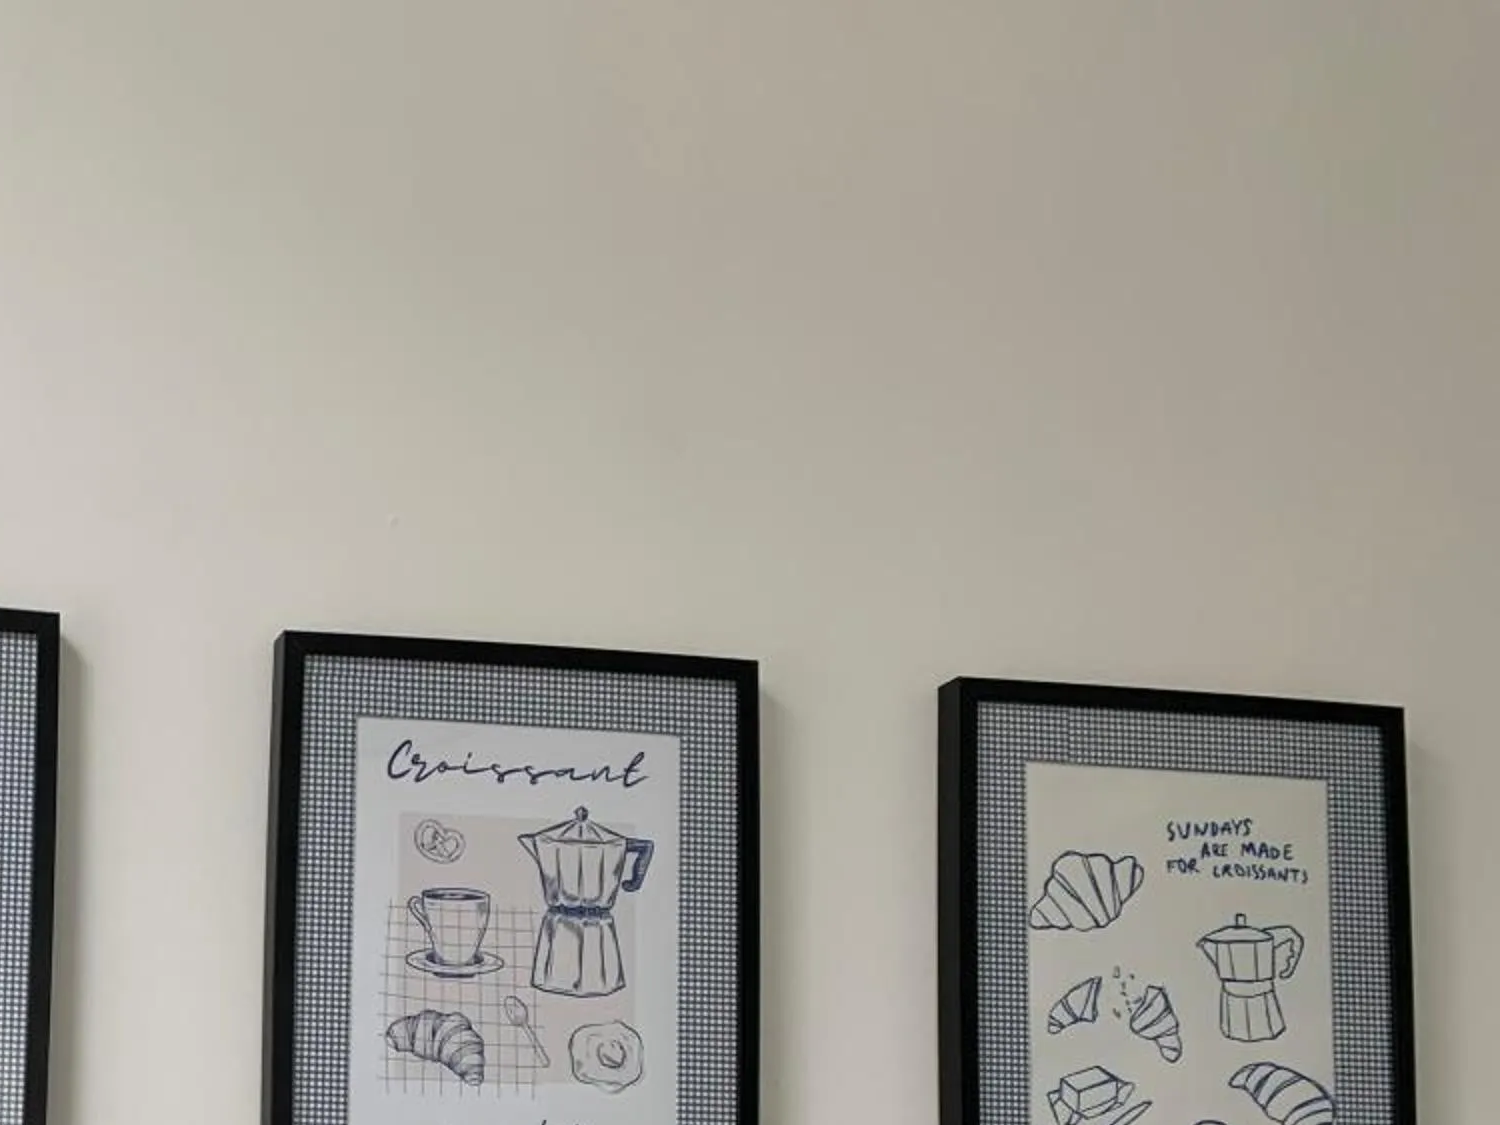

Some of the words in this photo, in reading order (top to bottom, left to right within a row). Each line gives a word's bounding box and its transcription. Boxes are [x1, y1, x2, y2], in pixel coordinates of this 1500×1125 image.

[387, 739, 651, 788] Croissant
[1166, 817, 1253, 842] SUNDAYS
[1200, 841, 1229, 859] ARE
[1241, 841, 1295, 861] MADE
[1166, 857, 1200, 874] FOR
[1212, 863, 1309, 884] CROISSANTS
